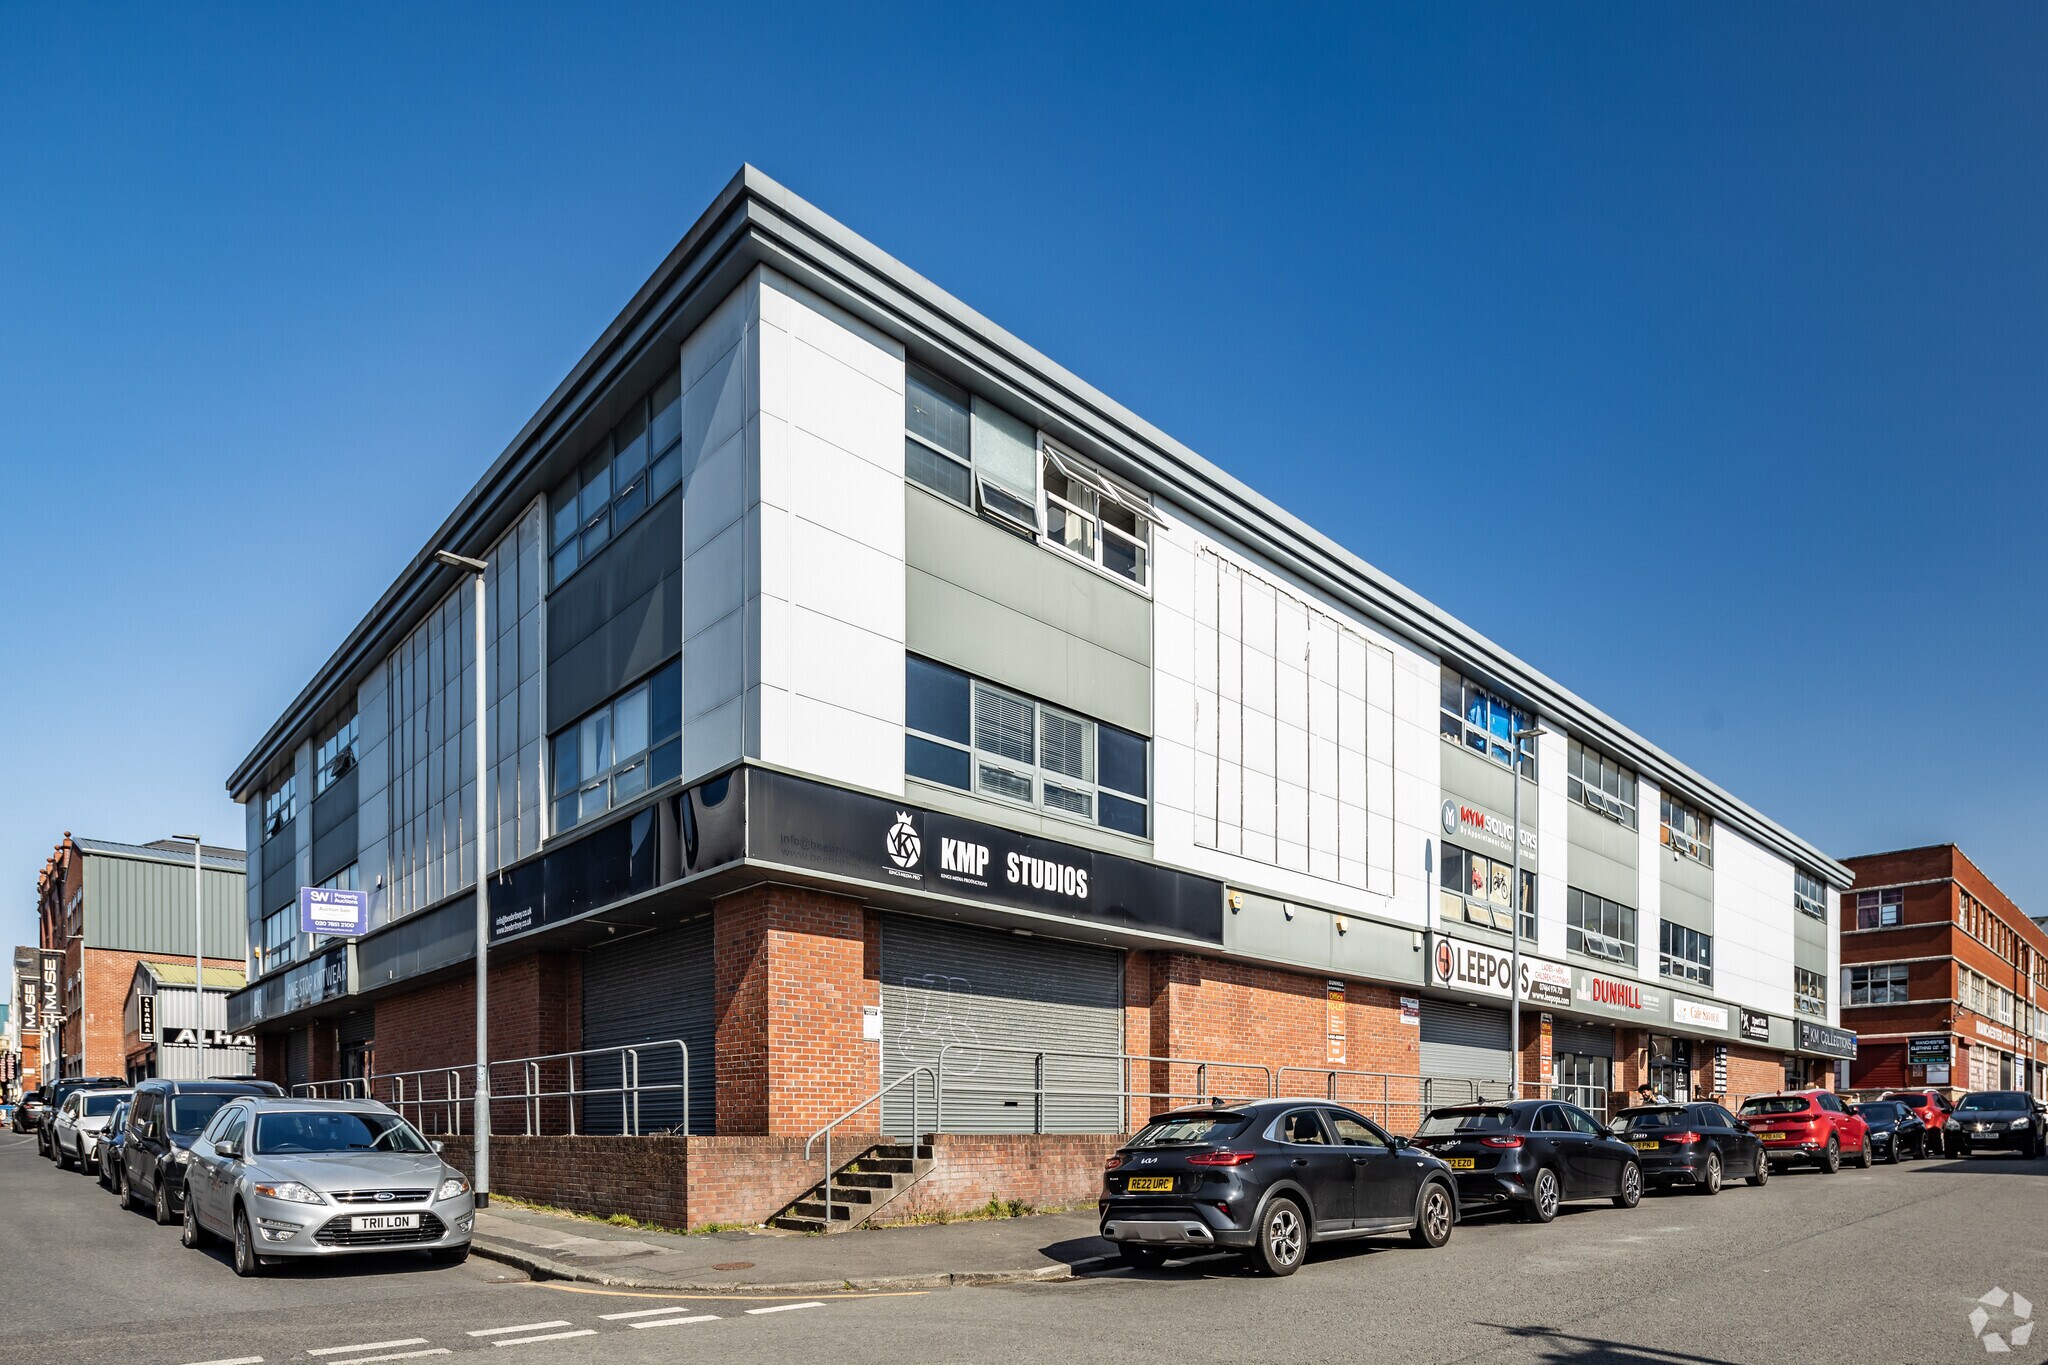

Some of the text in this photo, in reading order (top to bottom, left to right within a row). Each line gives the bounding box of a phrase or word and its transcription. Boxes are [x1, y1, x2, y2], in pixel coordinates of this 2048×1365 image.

[1460, 805, 1537, 850] MYM SOLICIORS
[1460, 825, 1467, 835] By
[1467, 828, 1501, 847] Appointment
[1501, 841, 1512, 853] Only
[940, 837, 1088, 899] KMP STUDIOS
[963, 877, 988, 888] PRODUCTIONS
[334, 893, 358, 901] Property
[1457, 947, 1529, 994] LEEPOS
[44, 958, 57, 1010] MUSE
[287, 981, 298, 1001] ONE
[299, 975, 312, 997] STOP
[1593, 978, 1642, 1010] DUNHILL
[24, 983, 36, 1028] MUSE
[1328, 1002, 1345, 1011] TO-LET
[1329, 992, 1344, 1001] Office
[1532, 991, 1570, 1005] www.leepops.com
[1809, 1028, 1820, 1044] KM
[1131, 1178, 1169, 1190] RE22 URC
[386, 1216, 410, 1229] LON
